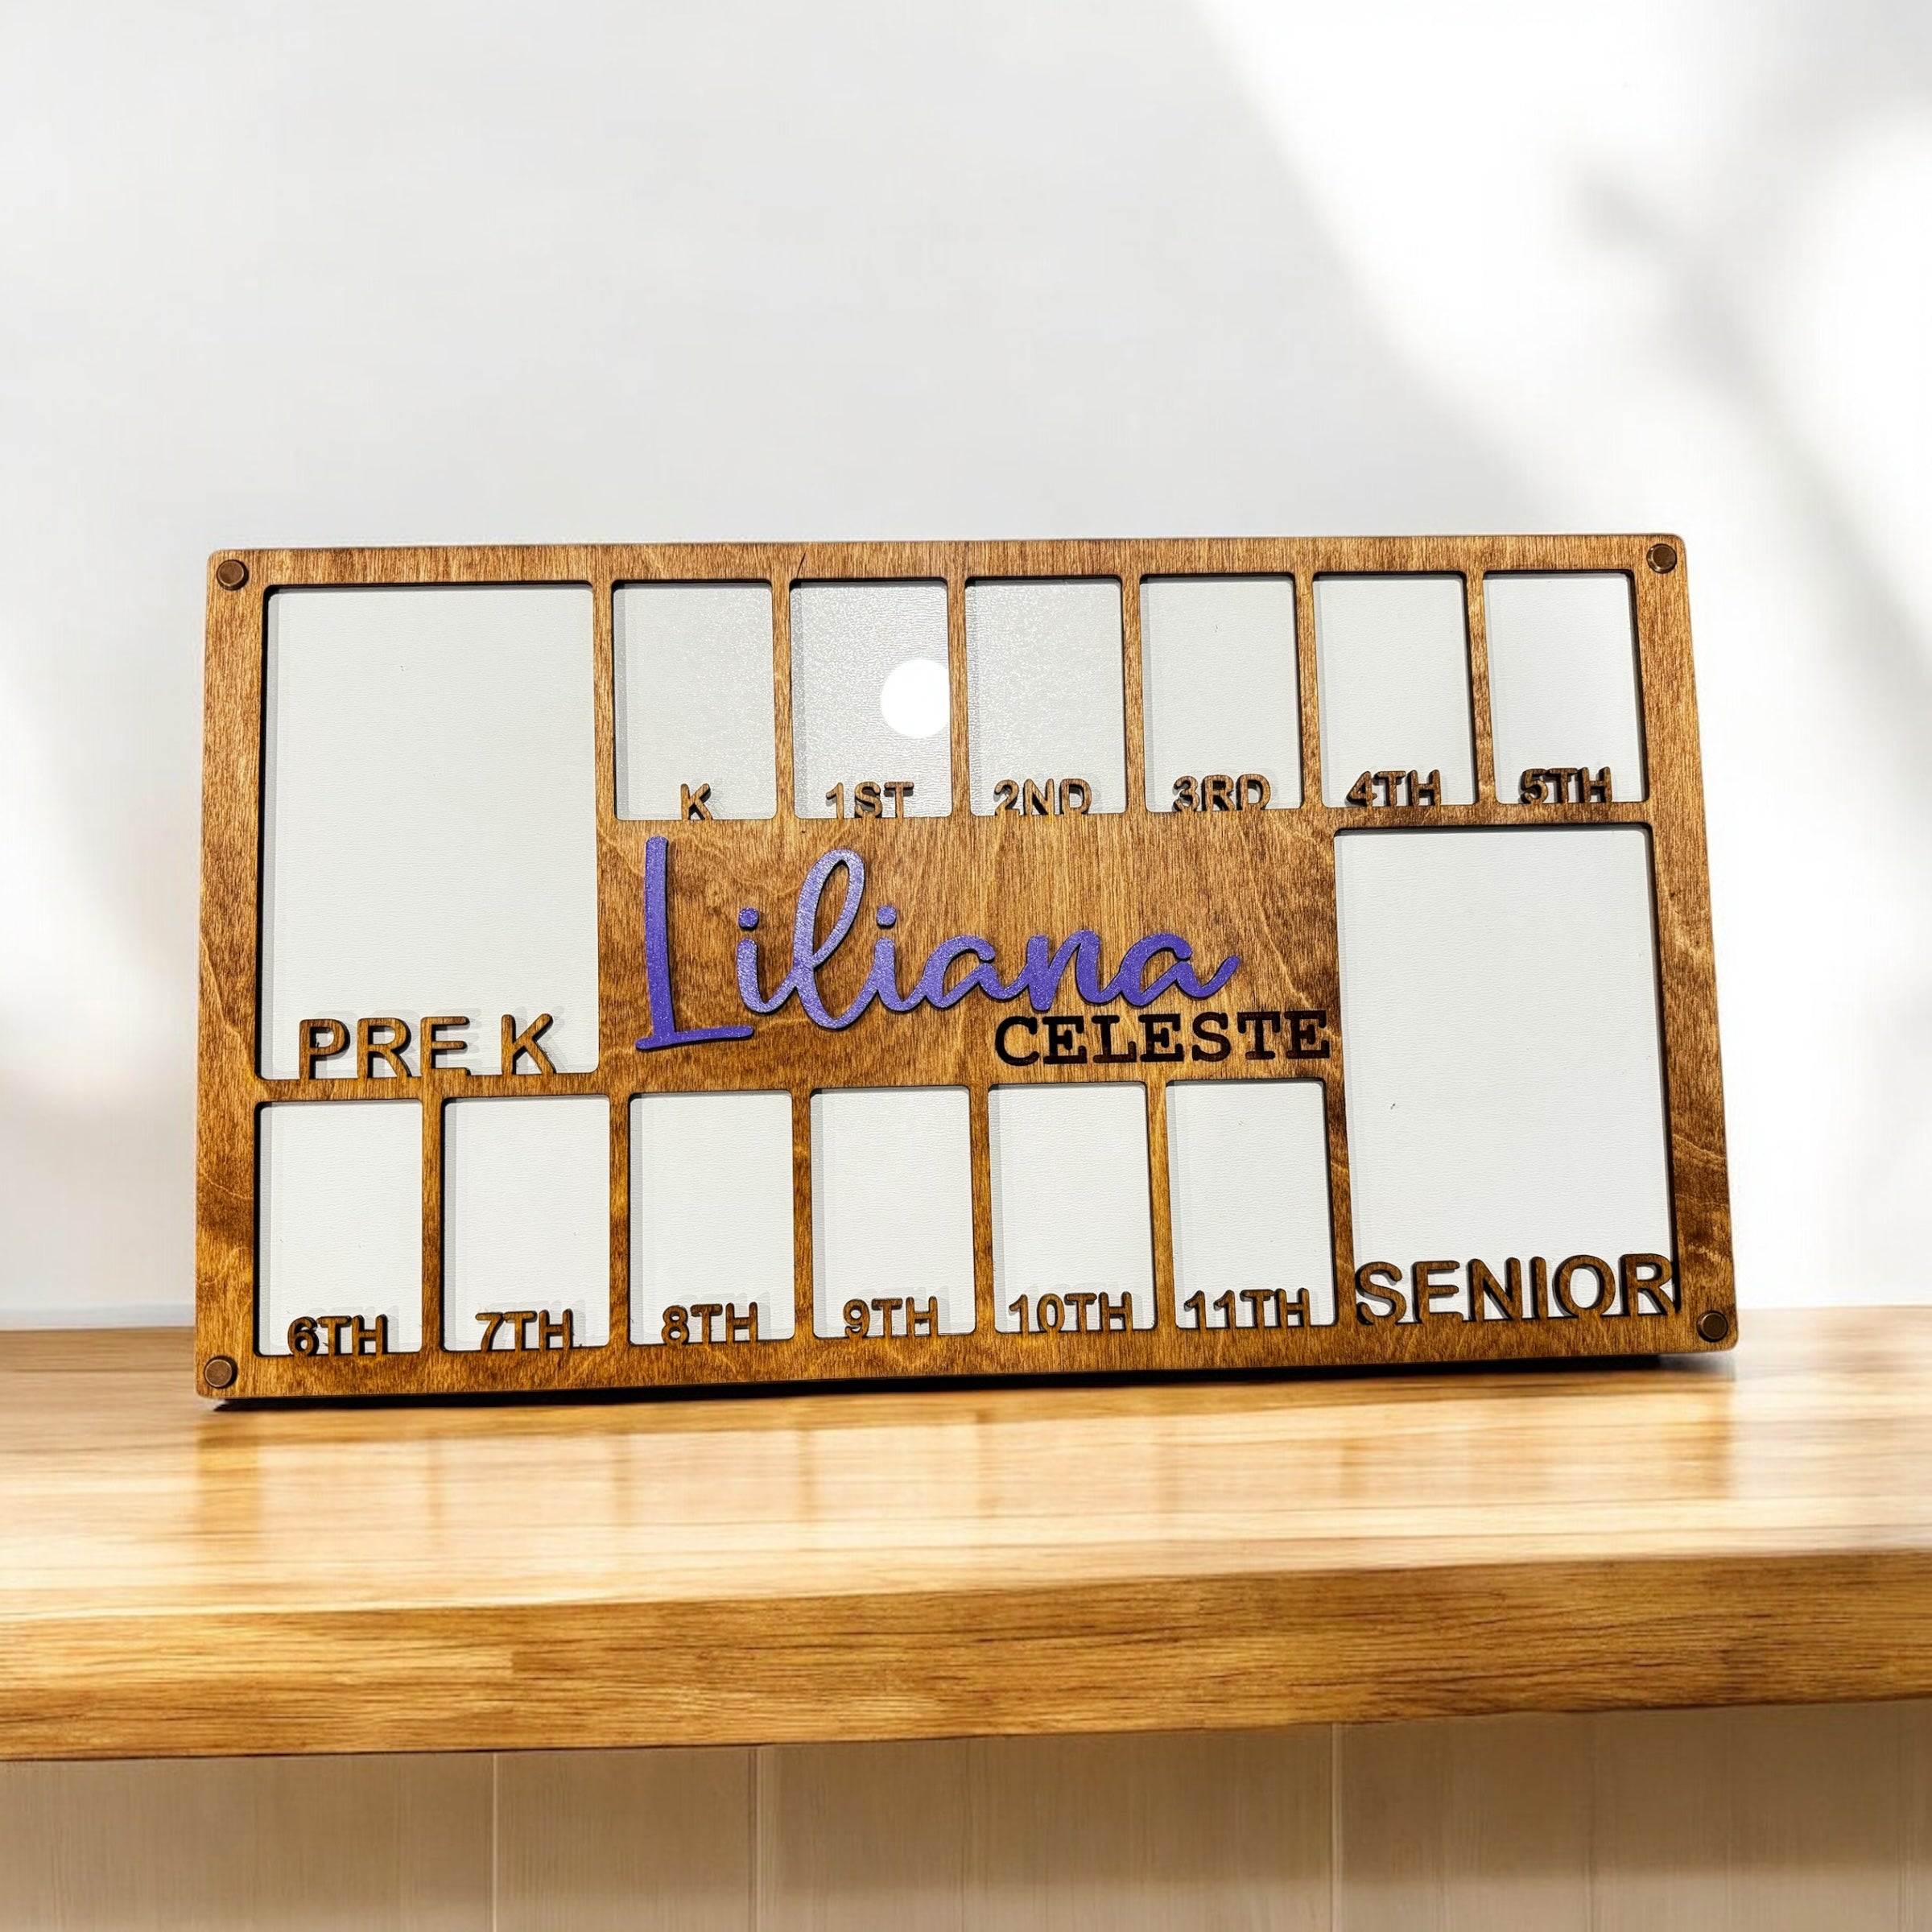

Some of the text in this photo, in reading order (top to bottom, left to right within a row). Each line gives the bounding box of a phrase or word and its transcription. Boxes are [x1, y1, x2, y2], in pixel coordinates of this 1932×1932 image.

[680, 782, 713, 820] K
[826, 781, 914, 819] 1ST
[993, 778, 1092, 816] 2ND
[1173, 774, 1272, 811] 3RD
[1345, 769, 1441, 807] 4TH
[1520, 766, 1612, 804] 5TH
[635, 835, 1241, 1051] Liliana
[299, 1012, 555, 1079] PRE K
[993, 1009, 1331, 1067] CELESTE
[1183, 1287, 1310, 1328] 11TH
[1354, 1253, 1681, 1325] SENIOR
[475, 1308, 574, 1352] 7TH
[661, 1302, 759, 1345] 8TH
[843, 1295, 938, 1338] 9TH
[1009, 1291, 1134, 1333] 10TH
[287, 1314, 389, 1356] 6TH
